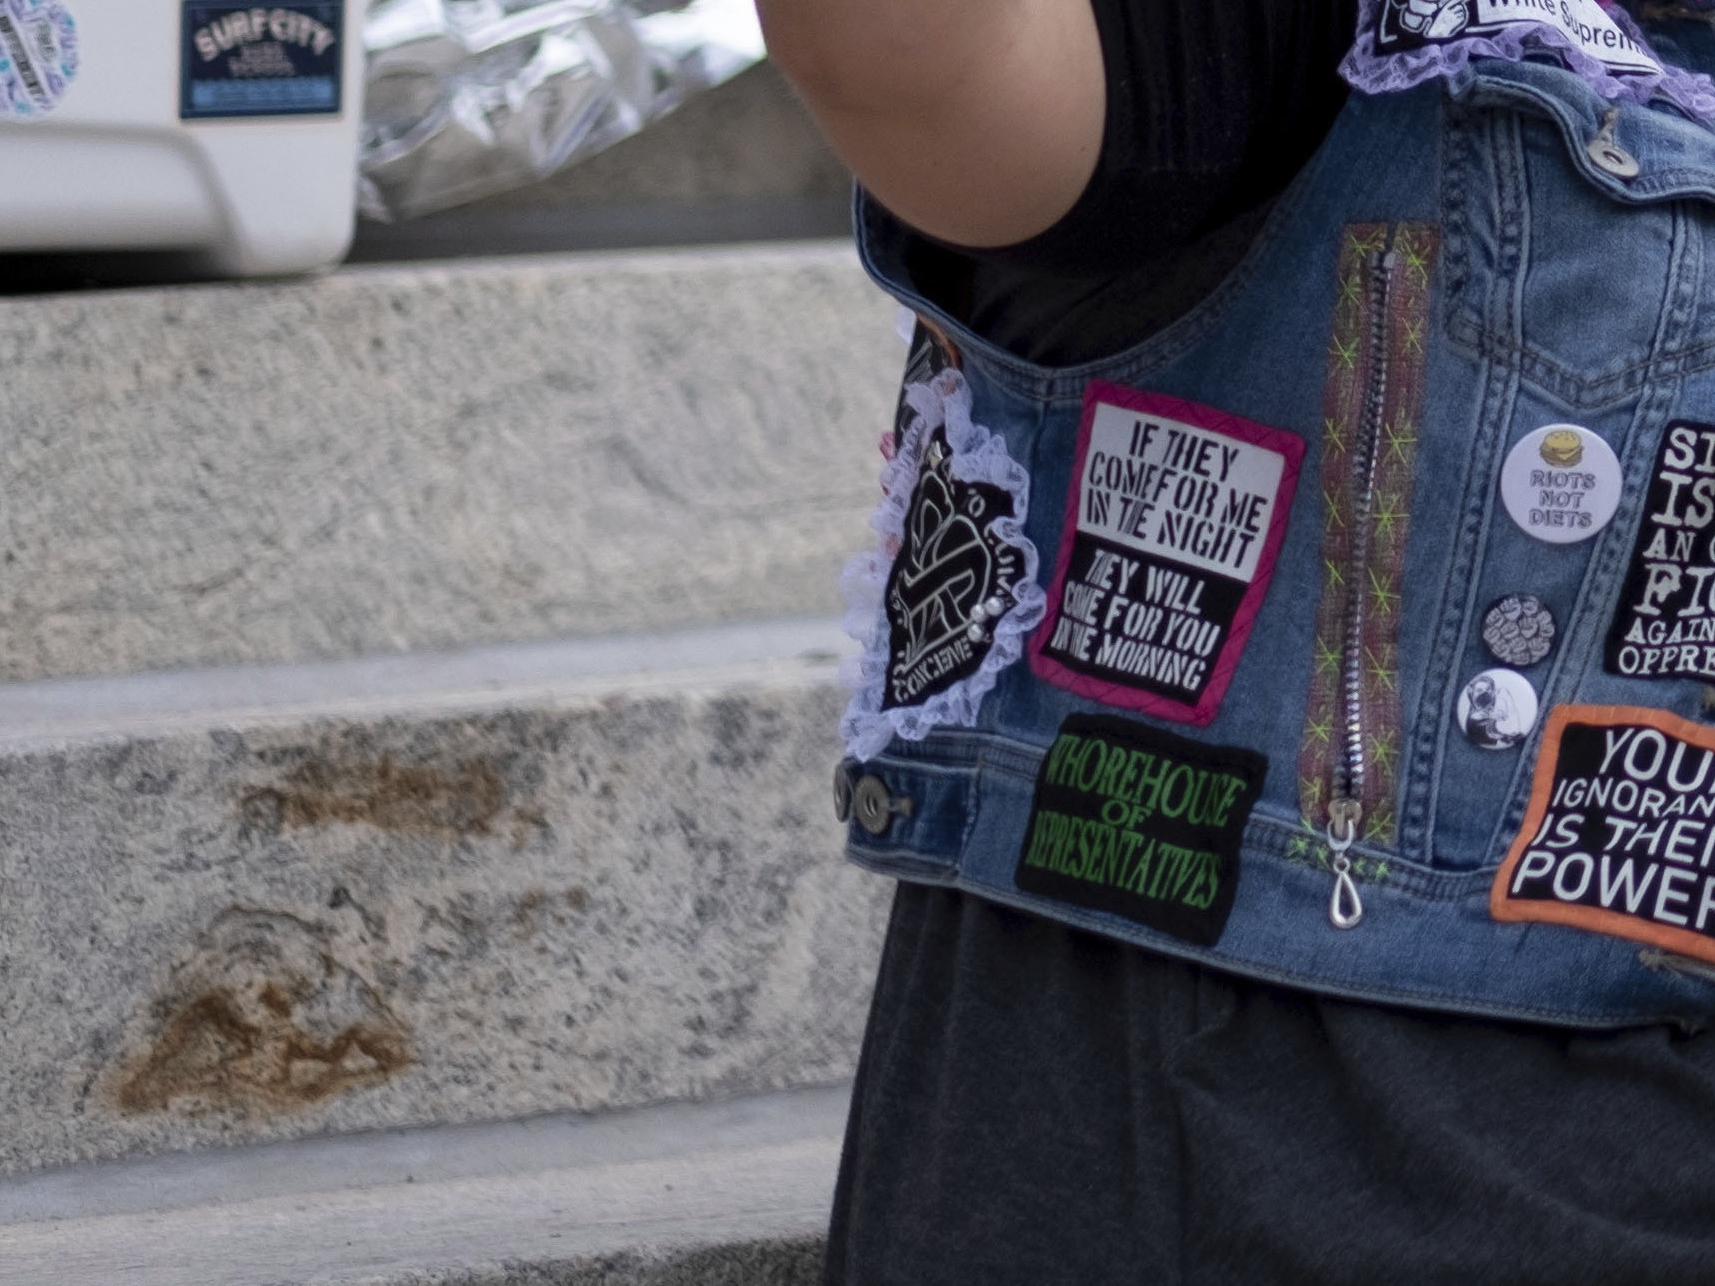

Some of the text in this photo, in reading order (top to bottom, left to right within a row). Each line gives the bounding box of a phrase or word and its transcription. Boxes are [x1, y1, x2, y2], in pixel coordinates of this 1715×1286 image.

[1129, 420, 1240, 482] IF THEY
[1088, 450, 1268, 534] COME FOR ME
[1530, 469, 1596, 491] RIOTS
[1539, 490, 1585, 509] NOT
[1086, 488, 1111, 526] IN
[1157, 510, 1255, 569] NIGHT
[1528, 508, 1593, 529] DIETS
[1642, 528, 1697, 563] AN
[1145, 565, 1205, 614] WILL
[1104, 596, 1163, 641] FOR
[1162, 610, 1221, 658] YOU
[1096, 633, 1207, 691] MORNING
[1047, 733, 1247, 827] WHOREHOUSE
[1101, 799, 1152, 828] OF
[1531, 813, 1585, 848] IS
[1025, 810, 1222, 910] REPRESENTATIVES
